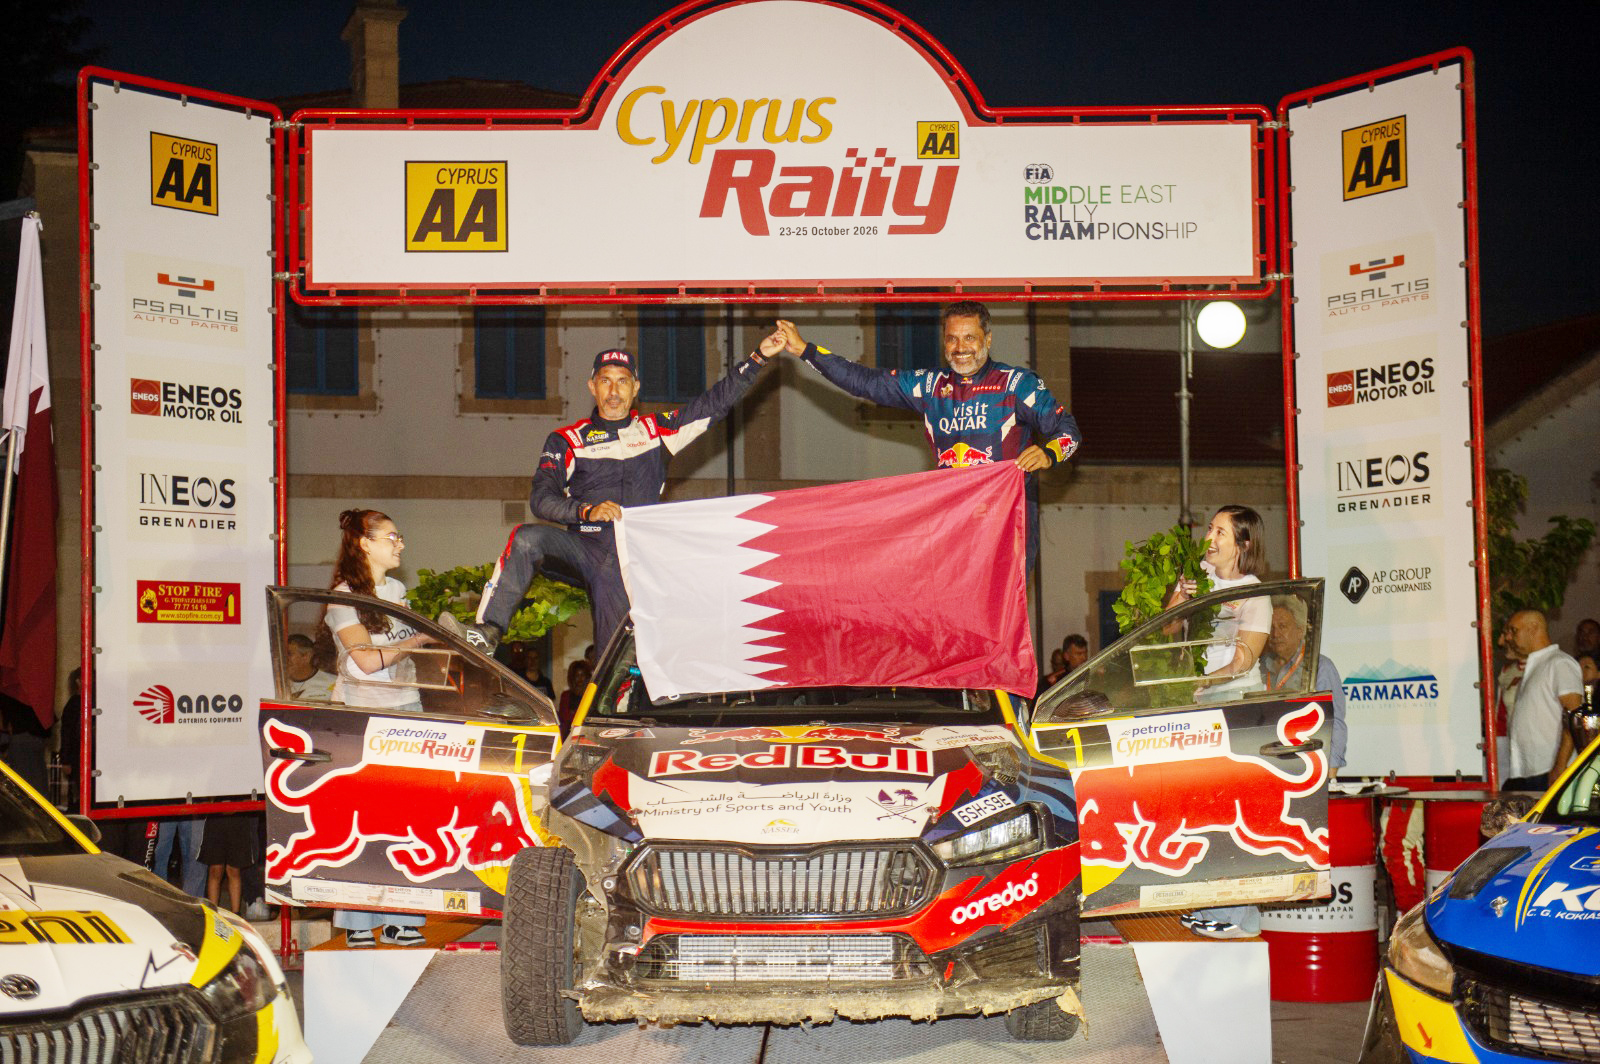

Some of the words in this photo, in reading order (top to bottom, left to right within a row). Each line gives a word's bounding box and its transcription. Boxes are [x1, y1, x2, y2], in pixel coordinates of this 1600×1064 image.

[616, 85, 837, 165] Cyprus
[929, 123, 956, 132] CYPRUS
[1361, 122, 1401, 144] CYPRUS
[171, 141, 212, 162] CYPRUS
[920, 132, 956, 155] AA
[1347, 138, 1401, 193] AA
[155, 157, 212, 207] AA
[436, 167, 498, 185] CYPRUS
[699, 147, 960, 236] Rally
[1024, 185, 1112, 205] MIDDLE
[1120, 184, 1177, 204] EAST
[411, 188, 498, 243] AA
[1024, 204, 1098, 223] RALLY
[779, 226, 808, 237] 23-25
[811, 226, 850, 237] October
[853, 226, 879, 237] 2026
[1025, 221, 1198, 241] CHAMPIONSHIP
[1327, 277, 1430, 308] PSALTIS
[133, 298, 239, 323] PSALTIS
[1328, 304, 1371, 318] AUTO
[1381, 292, 1430, 308] PARTS
[133, 313, 179, 325] AUTO
[190, 320, 239, 333] PARTS
[1356, 357, 1435, 389] ENEOS
[132, 392, 159, 402] ENEOS
[162, 381, 242, 410] ENEOS
[1328, 383, 1353, 394] ENEOS
[1356, 384, 1407, 404] MOTOR
[1412, 380, 1435, 395] OIL
[163, 404, 216, 422] MOTOR
[220, 409, 243, 424] OIL
[953, 401, 989, 418] visit
[938, 415, 987, 434] QATAR
[1336, 451, 1430, 492] INEOS
[139, 472, 236, 509] INEOS
[1337, 494, 1431, 513] GRENADIER
[139, 516, 236, 530] GRENADIER
[1371, 570, 1387, 583] AP
[1389, 567, 1431, 581] GROUP
[158, 584, 190, 597] STOP
[194, 585, 222, 598] FIRE
[1347, 577, 1362, 594] AP
[1372, 584, 1383, 595] OF
[1384, 581, 1432, 593] COMPANIES
[160, 612, 221, 620] www.stopfire.com.cy
[177, 694, 243, 714] anco
[209, 716, 243, 724] EQUIPMENT
[1131, 721, 1191, 738] petrolina
[387, 728, 447, 741] petrolina
[511, 733, 527, 774] 1
[1066, 728, 1084, 769] 1
[648, 745, 792, 778] Red
[797, 746, 934, 776] Bull
[823, 791, 852, 803] وزارة
[643, 807, 702, 817] Ministry
[706, 803, 722, 813] of
[725, 803, 774, 814] Sports
[778, 802, 805, 811] and
[809, 802, 852, 814] Youth
[760, 826, 800, 835] NASSER
[1294, 879, 1315, 893] AA
[446, 897, 466, 910] AA
[951, 872, 1039, 924] ooredoo
[1526, 908, 1537, 917] C.
[1540, 908, 1552, 918] G.
